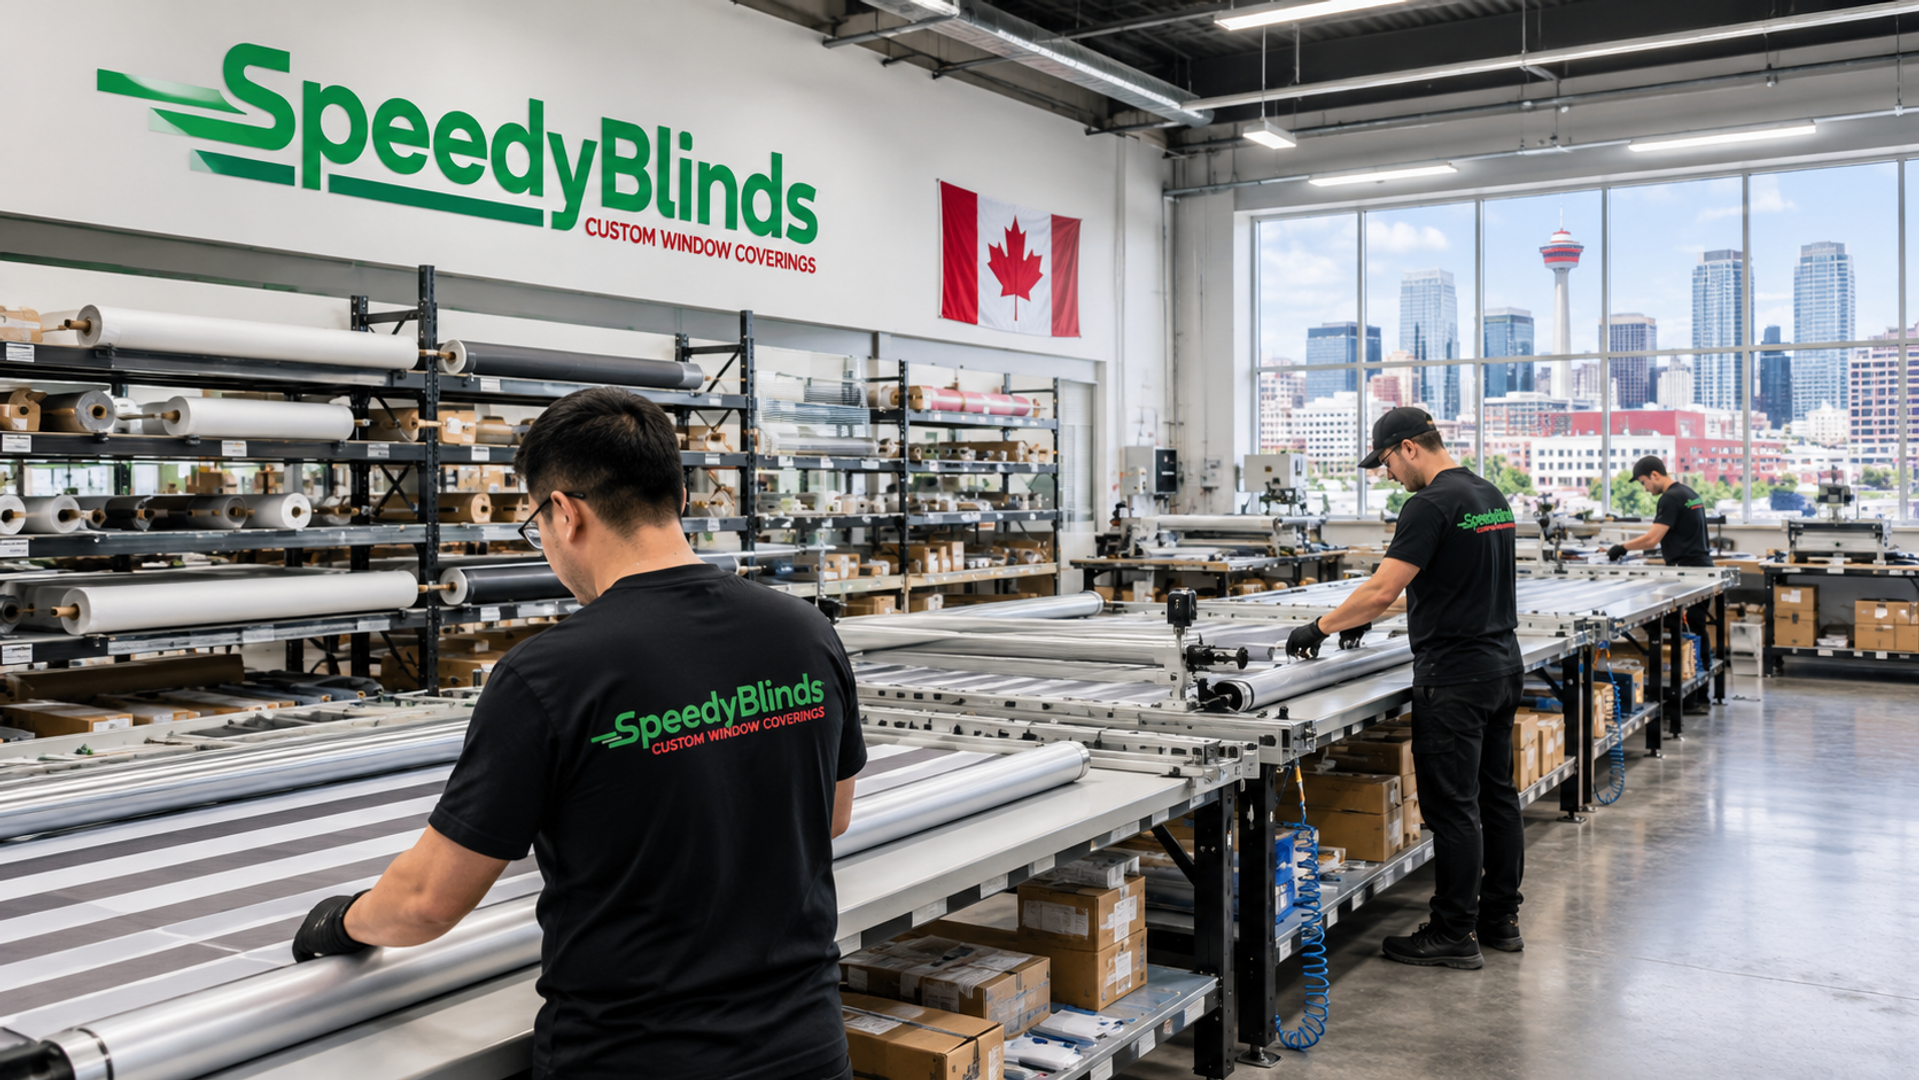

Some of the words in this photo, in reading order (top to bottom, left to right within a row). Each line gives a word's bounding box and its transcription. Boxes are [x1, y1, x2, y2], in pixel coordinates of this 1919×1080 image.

[151, 43, 819, 245] SpeedyBlinds
[585, 217, 656, 247] CUSTOM
[660, 229, 733, 260] WINDOW
[735, 243, 817, 274] COVERINGS
[608, 672, 825, 750] SpeedyBlinds
[651, 732, 705, 756] CUSTOM
[707, 719, 761, 742] WINDOW
[763, 705, 826, 730] COVERINGS
